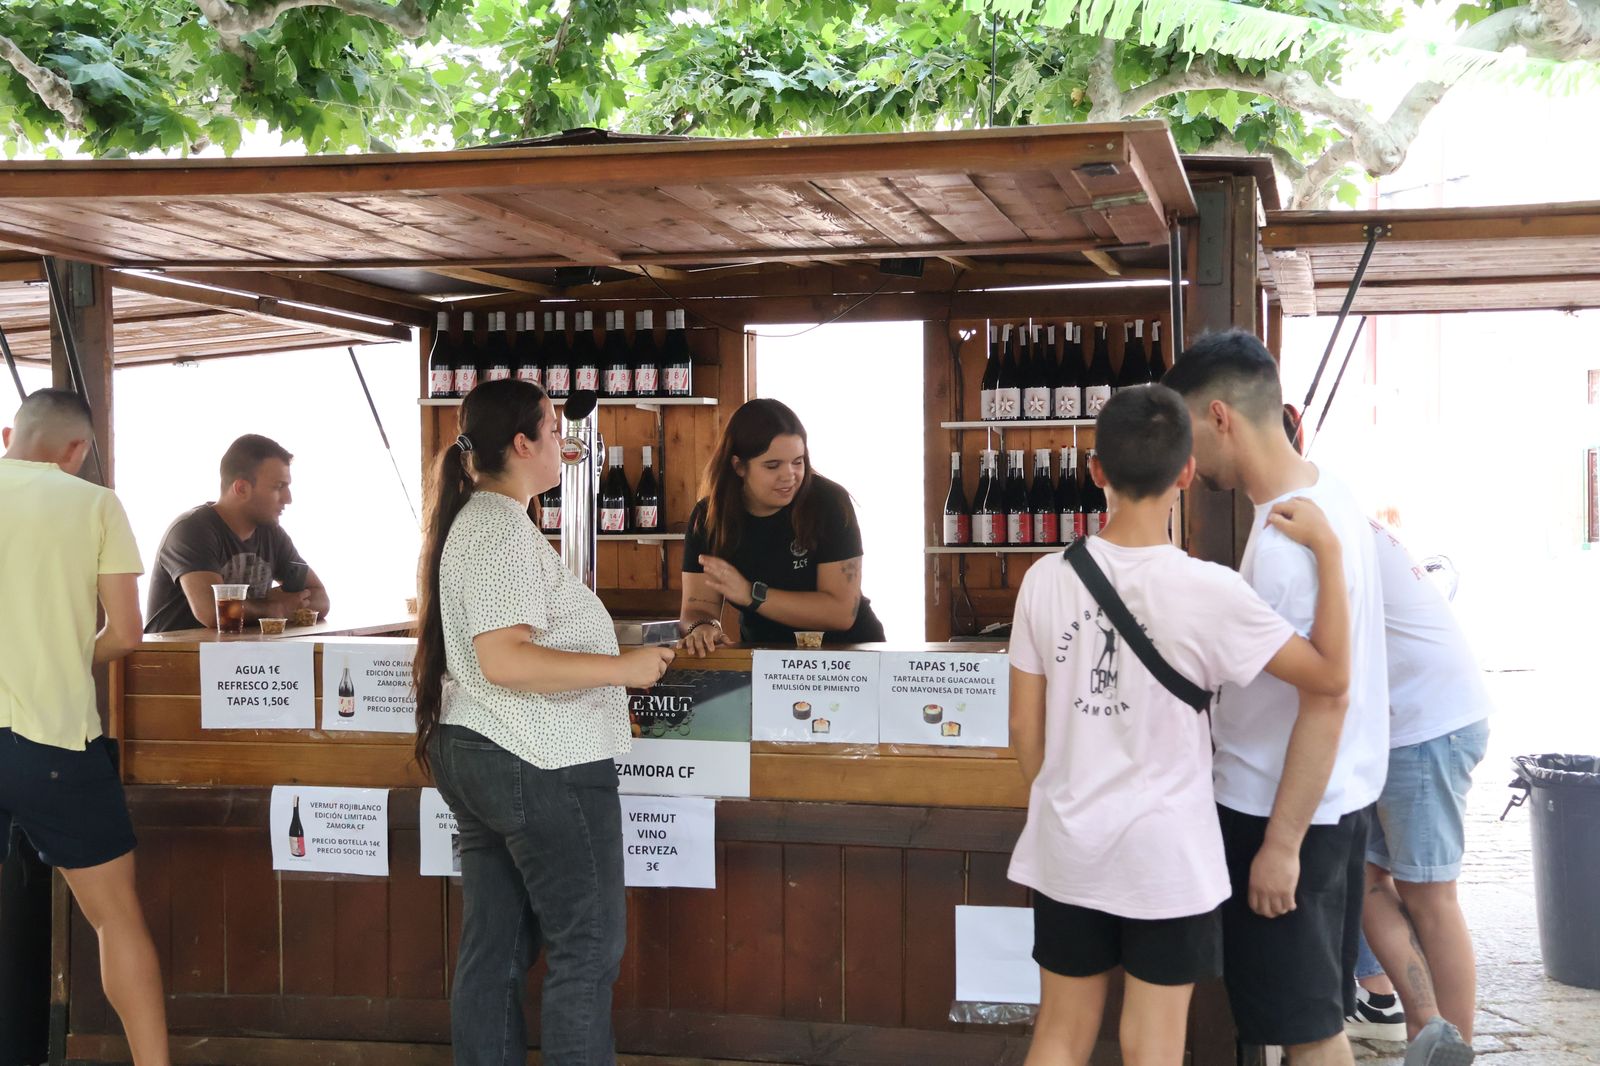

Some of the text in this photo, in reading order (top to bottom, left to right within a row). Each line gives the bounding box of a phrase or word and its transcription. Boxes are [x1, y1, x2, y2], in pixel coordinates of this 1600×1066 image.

[792, 558, 809, 570] ZCF
[1055, 622, 1081, 663] CLUB
[392, 660, 414, 668] CRIAN
[781, 659, 851, 671] TAPAS 1,50€
[909, 660, 980, 674] TAPAS 1,50€
[235, 665, 281, 676] AGUA 1€
[366, 668, 394, 677] EDICIÓN
[764, 672, 868, 683] TARTALETA DE SALMÓN CON
[893, 675, 996, 685] TARTALETA DE GUACAMOLE
[217, 681, 299, 692] REFRESCO 2,50€
[408, 680, 413, 688] C
[772, 682, 860, 693] EMULSIÓN DE PIMIENTO
[891, 685, 997, 696] CON MAYONESA DE TOMATE
[227, 696, 290, 707] TAPAS 1,50€
[387, 696, 418, 704] BOTELLA
[392, 706, 414, 714] SOCIO
[615, 763, 696, 779] ZAMORA CF
[310, 802, 382, 812] VERMUT ROJIBLANCO
[314, 811, 377, 821] EDICIÓN LIMITADA
[435, 812, 456, 820] ARTES
[628, 812, 677, 824] VERMUT
[326, 822, 366, 831] ZAMORA CF
[438, 822, 448, 830] DE
[637, 829, 667, 840] VINO
[312, 838, 381, 848] PRECIO BOTELLA 14€
[316, 847, 377, 857] PRECIO SOCIO 12€
[627, 844, 679, 856] CERVEZA
[646, 861, 660, 872] 3€
